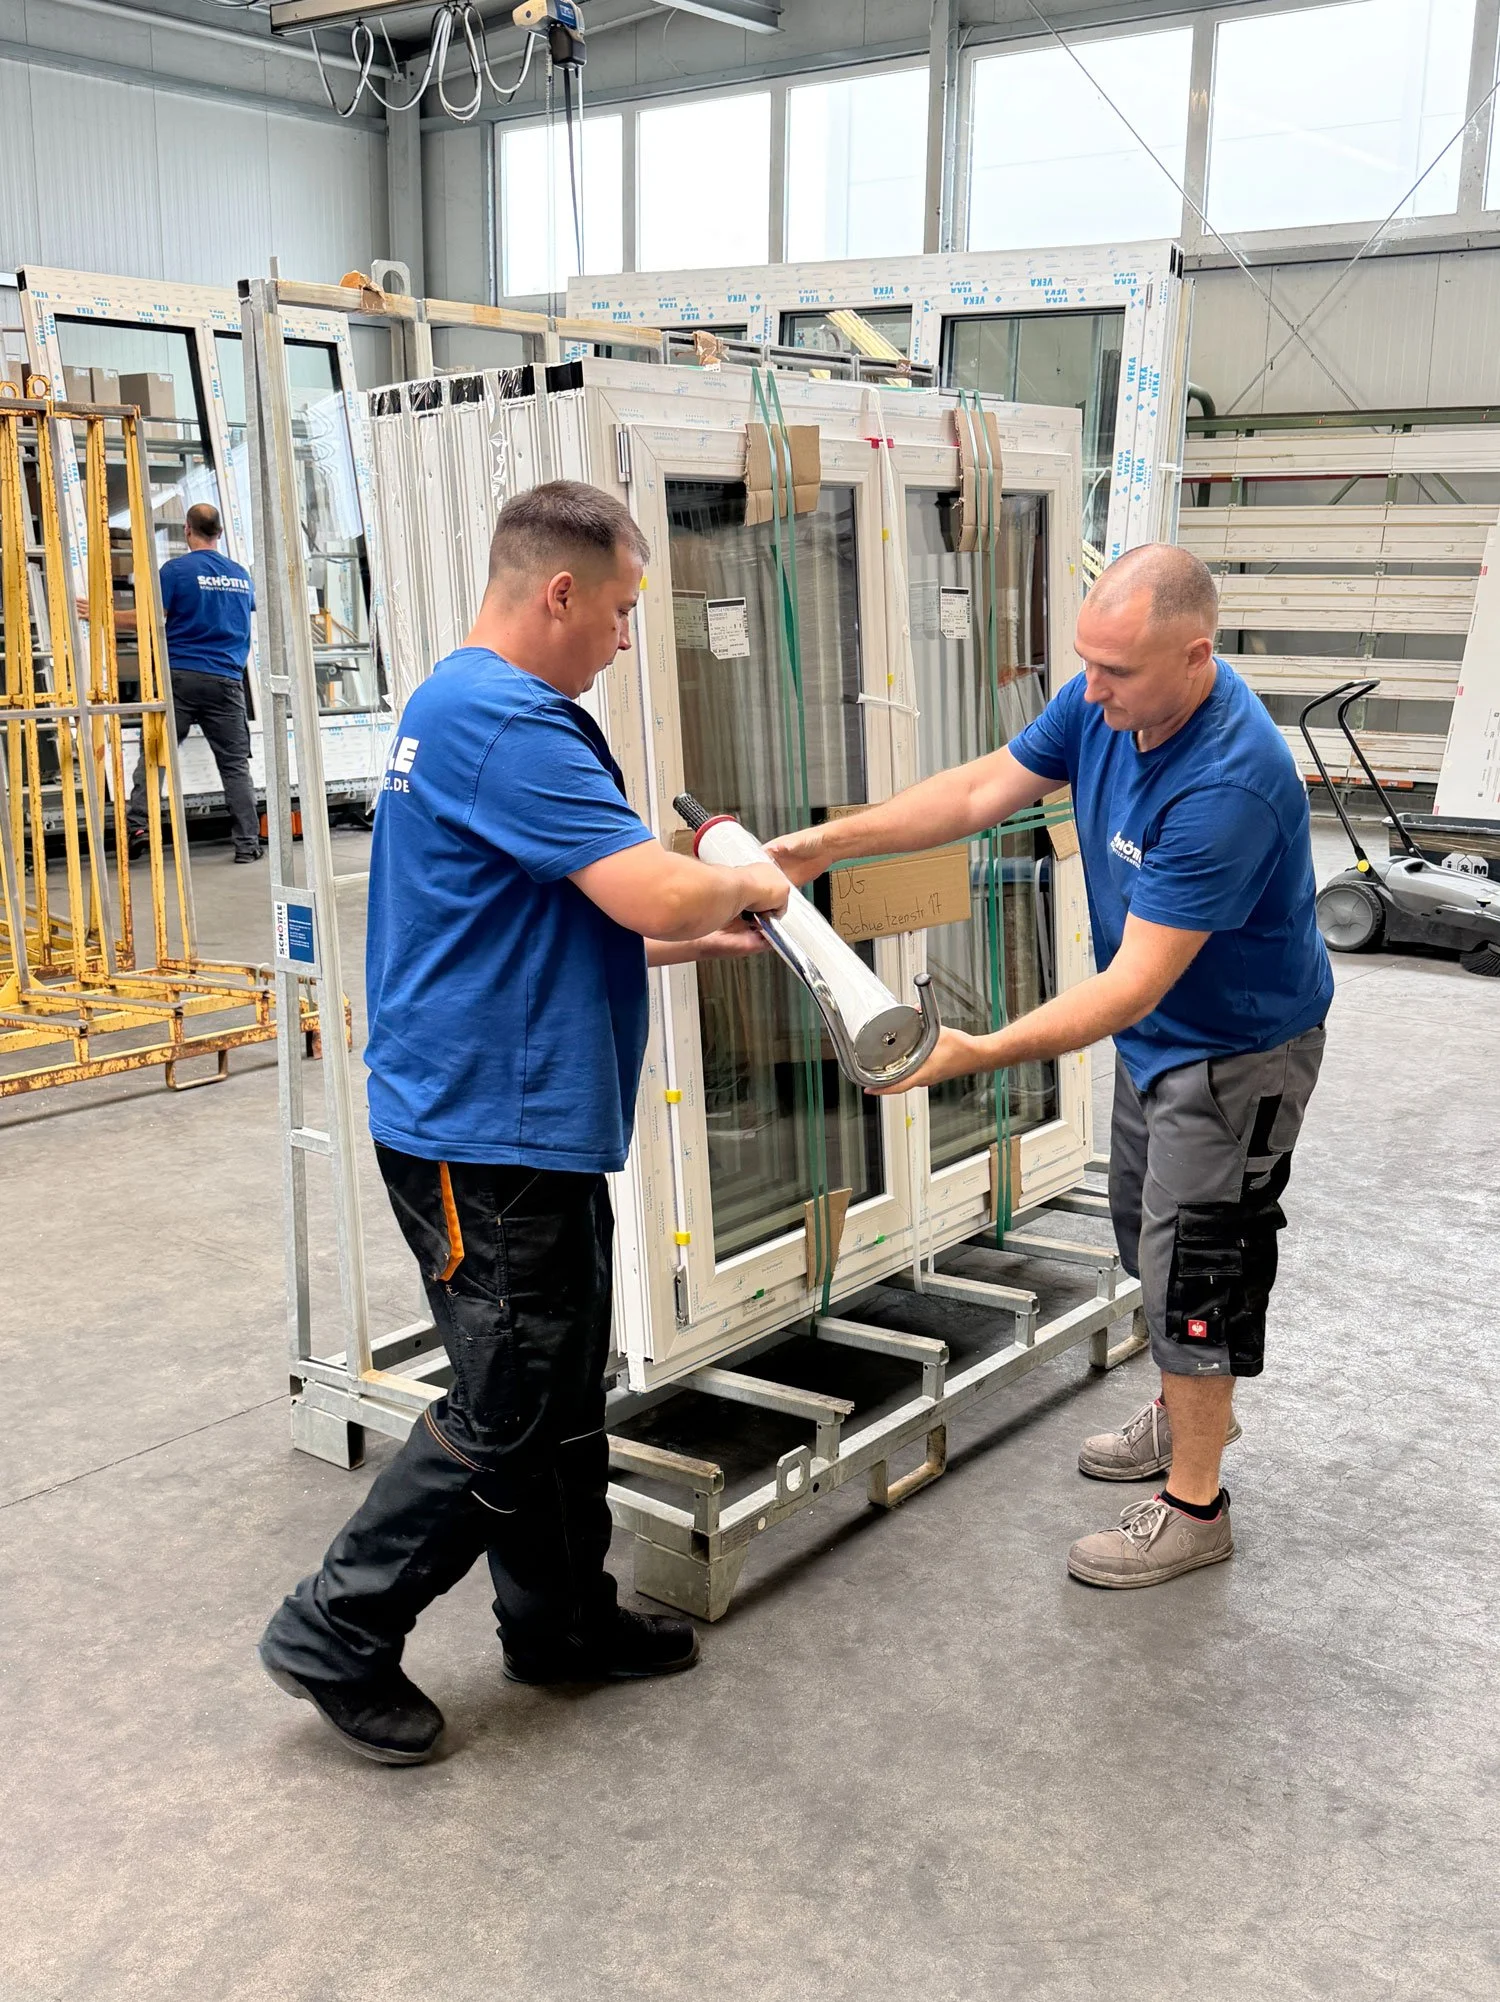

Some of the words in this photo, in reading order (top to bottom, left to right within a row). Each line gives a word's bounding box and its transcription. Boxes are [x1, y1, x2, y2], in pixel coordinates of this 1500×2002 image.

[1031, 277, 1053, 286] VEKA
[873, 286, 894, 294] VEKA
[727, 294, 747, 303] VEKA
[799, 294, 820, 303] VEKA
[963, 296, 986, 305] VEKA
[592, 301, 610, 310] VEKA
[76, 307, 94, 315] VEKA
[612, 311, 631, 320] VEKA
[681, 312, 700, 321] VEKA
[1127, 356, 1136, 383] VEKA
[1138, 366, 1148, 392] VEKA
[1152, 372, 1160, 398] VEKA
[1124, 449, 1132, 475] VEKA
[1135, 457, 1145, 483] VEKA
[1112, 542, 1120, 561] EKA
[1460, 865, 1470, 873] &
[1474, 865, 1487, 875] M
[928, 892, 942, 916] 17
[276, 904, 285, 955] SCHÖTTLE
